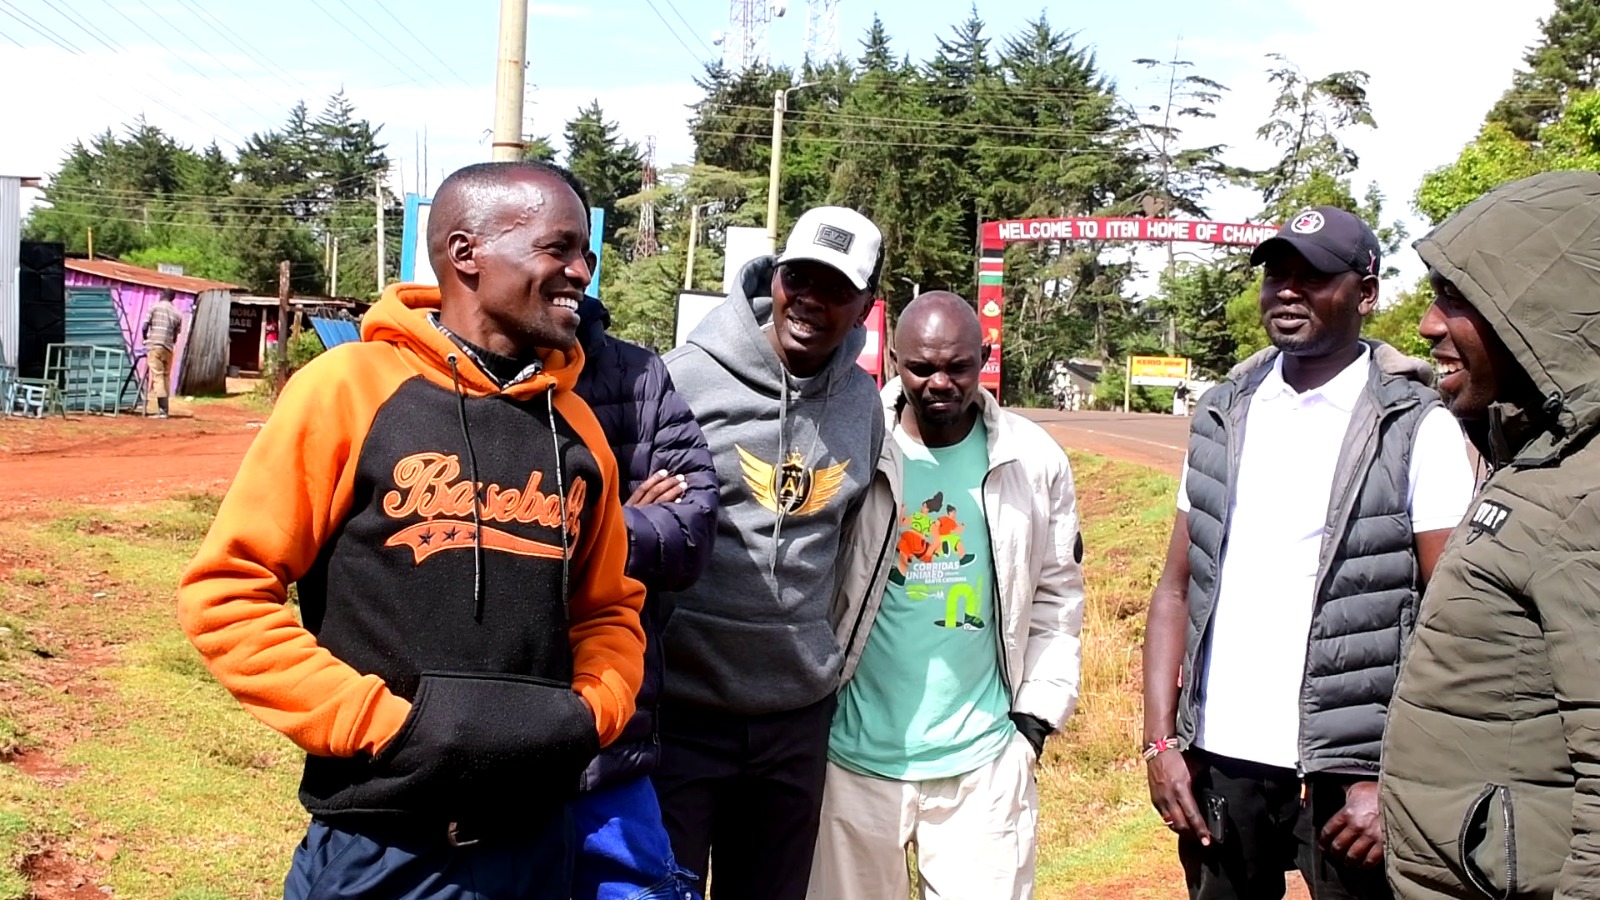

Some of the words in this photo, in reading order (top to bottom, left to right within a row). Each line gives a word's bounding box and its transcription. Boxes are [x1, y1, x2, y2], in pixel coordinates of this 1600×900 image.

[998, 220, 1072, 239] WELCOME
[1076, 221, 1098, 238] TO
[1106, 221, 1139, 238] ITEN
[1147, 221, 1189, 239] HOME
[1195, 223, 1217, 240] OF
[383, 452, 587, 536] Baseball
[913, 561, 960, 571] CORRIDAS
[906, 570, 944, 581] UNIMED
